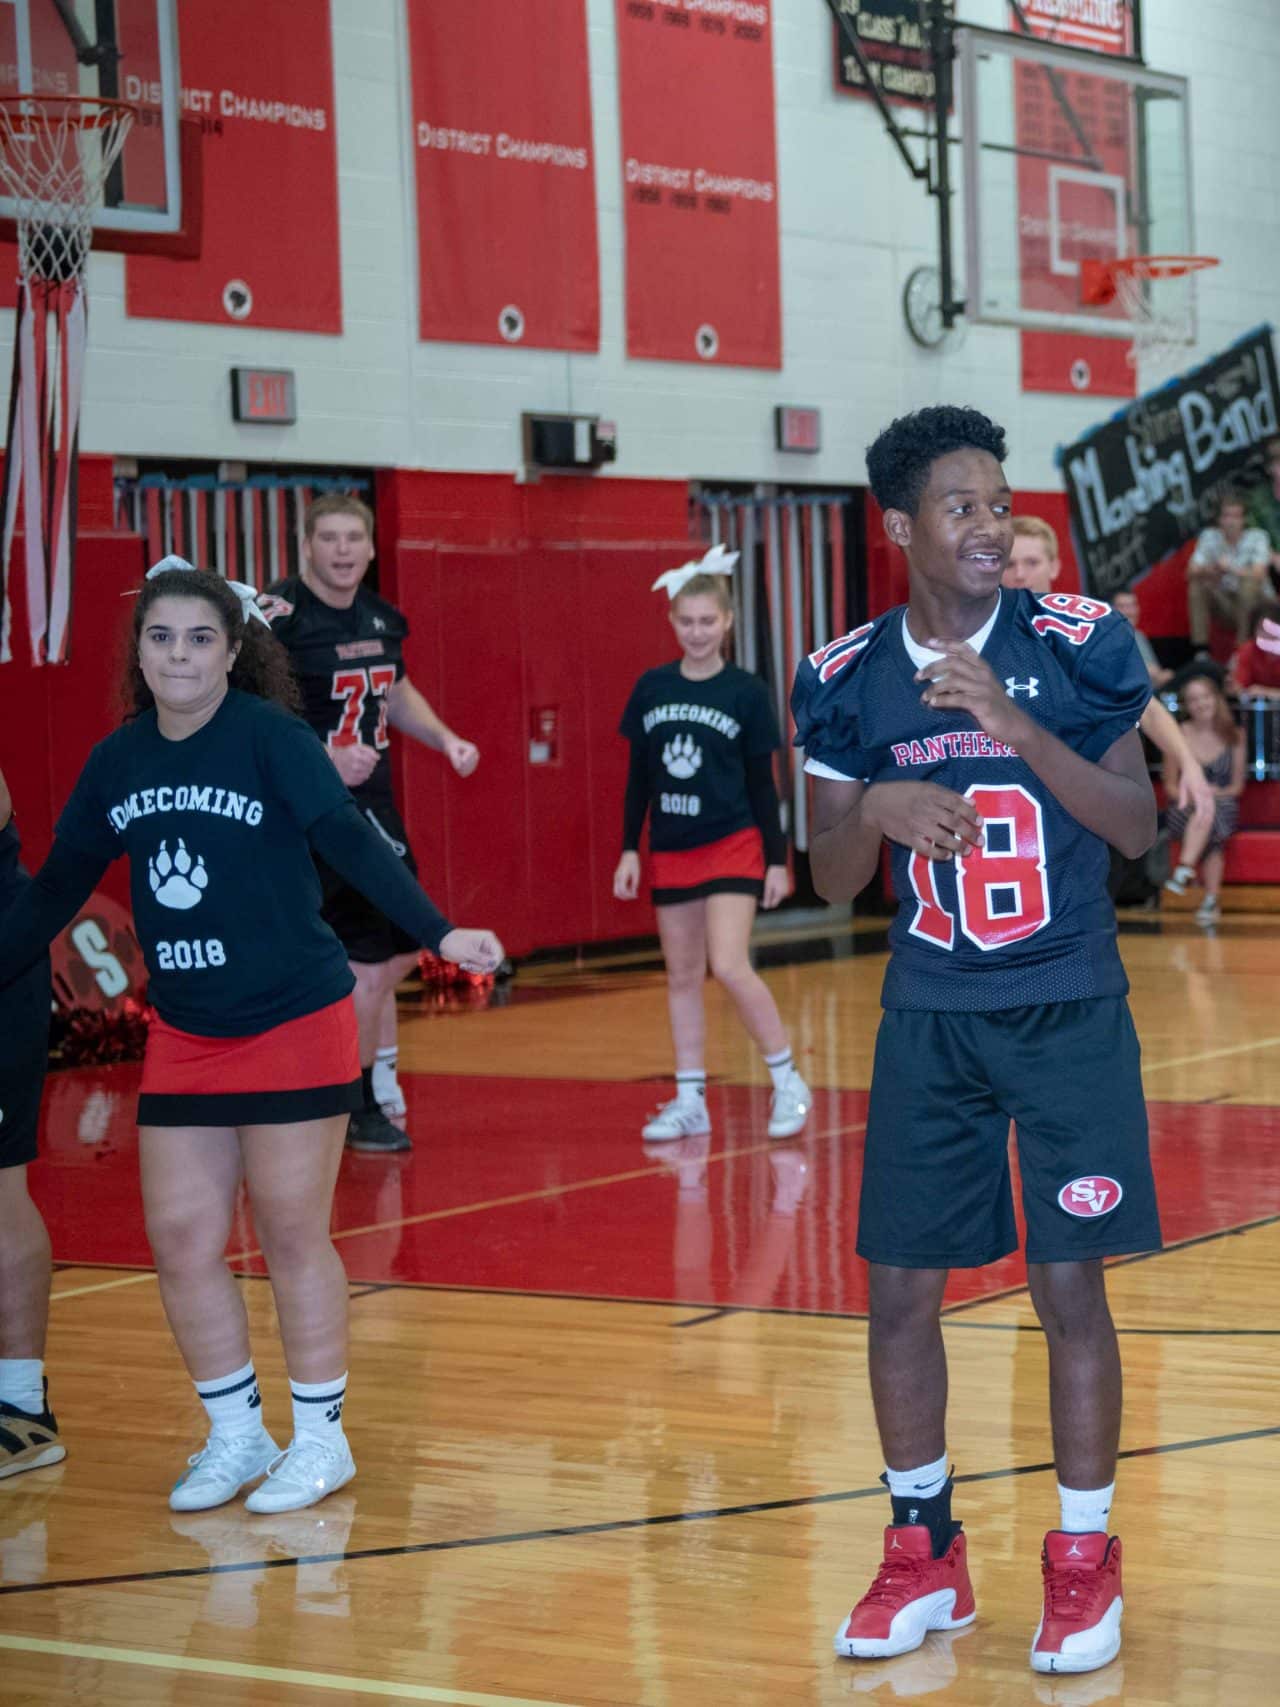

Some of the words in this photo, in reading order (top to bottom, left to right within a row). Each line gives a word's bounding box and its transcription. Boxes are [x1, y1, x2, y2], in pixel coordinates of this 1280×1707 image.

[126, 75, 213, 113] DISICT
[220, 88, 327, 131] CHAMPIONS
[417, 120, 492, 155] DISTRICT
[496, 132, 588, 169] CHAMPIONS
[1178, 345, 1279, 473] Band
[1031, 592, 1113, 646] 18
[327, 664, 397, 750] 77
[107, 785, 264, 835] OMECOMING
[907, 783, 1052, 952] 18
[156, 938, 227, 970] 2018
